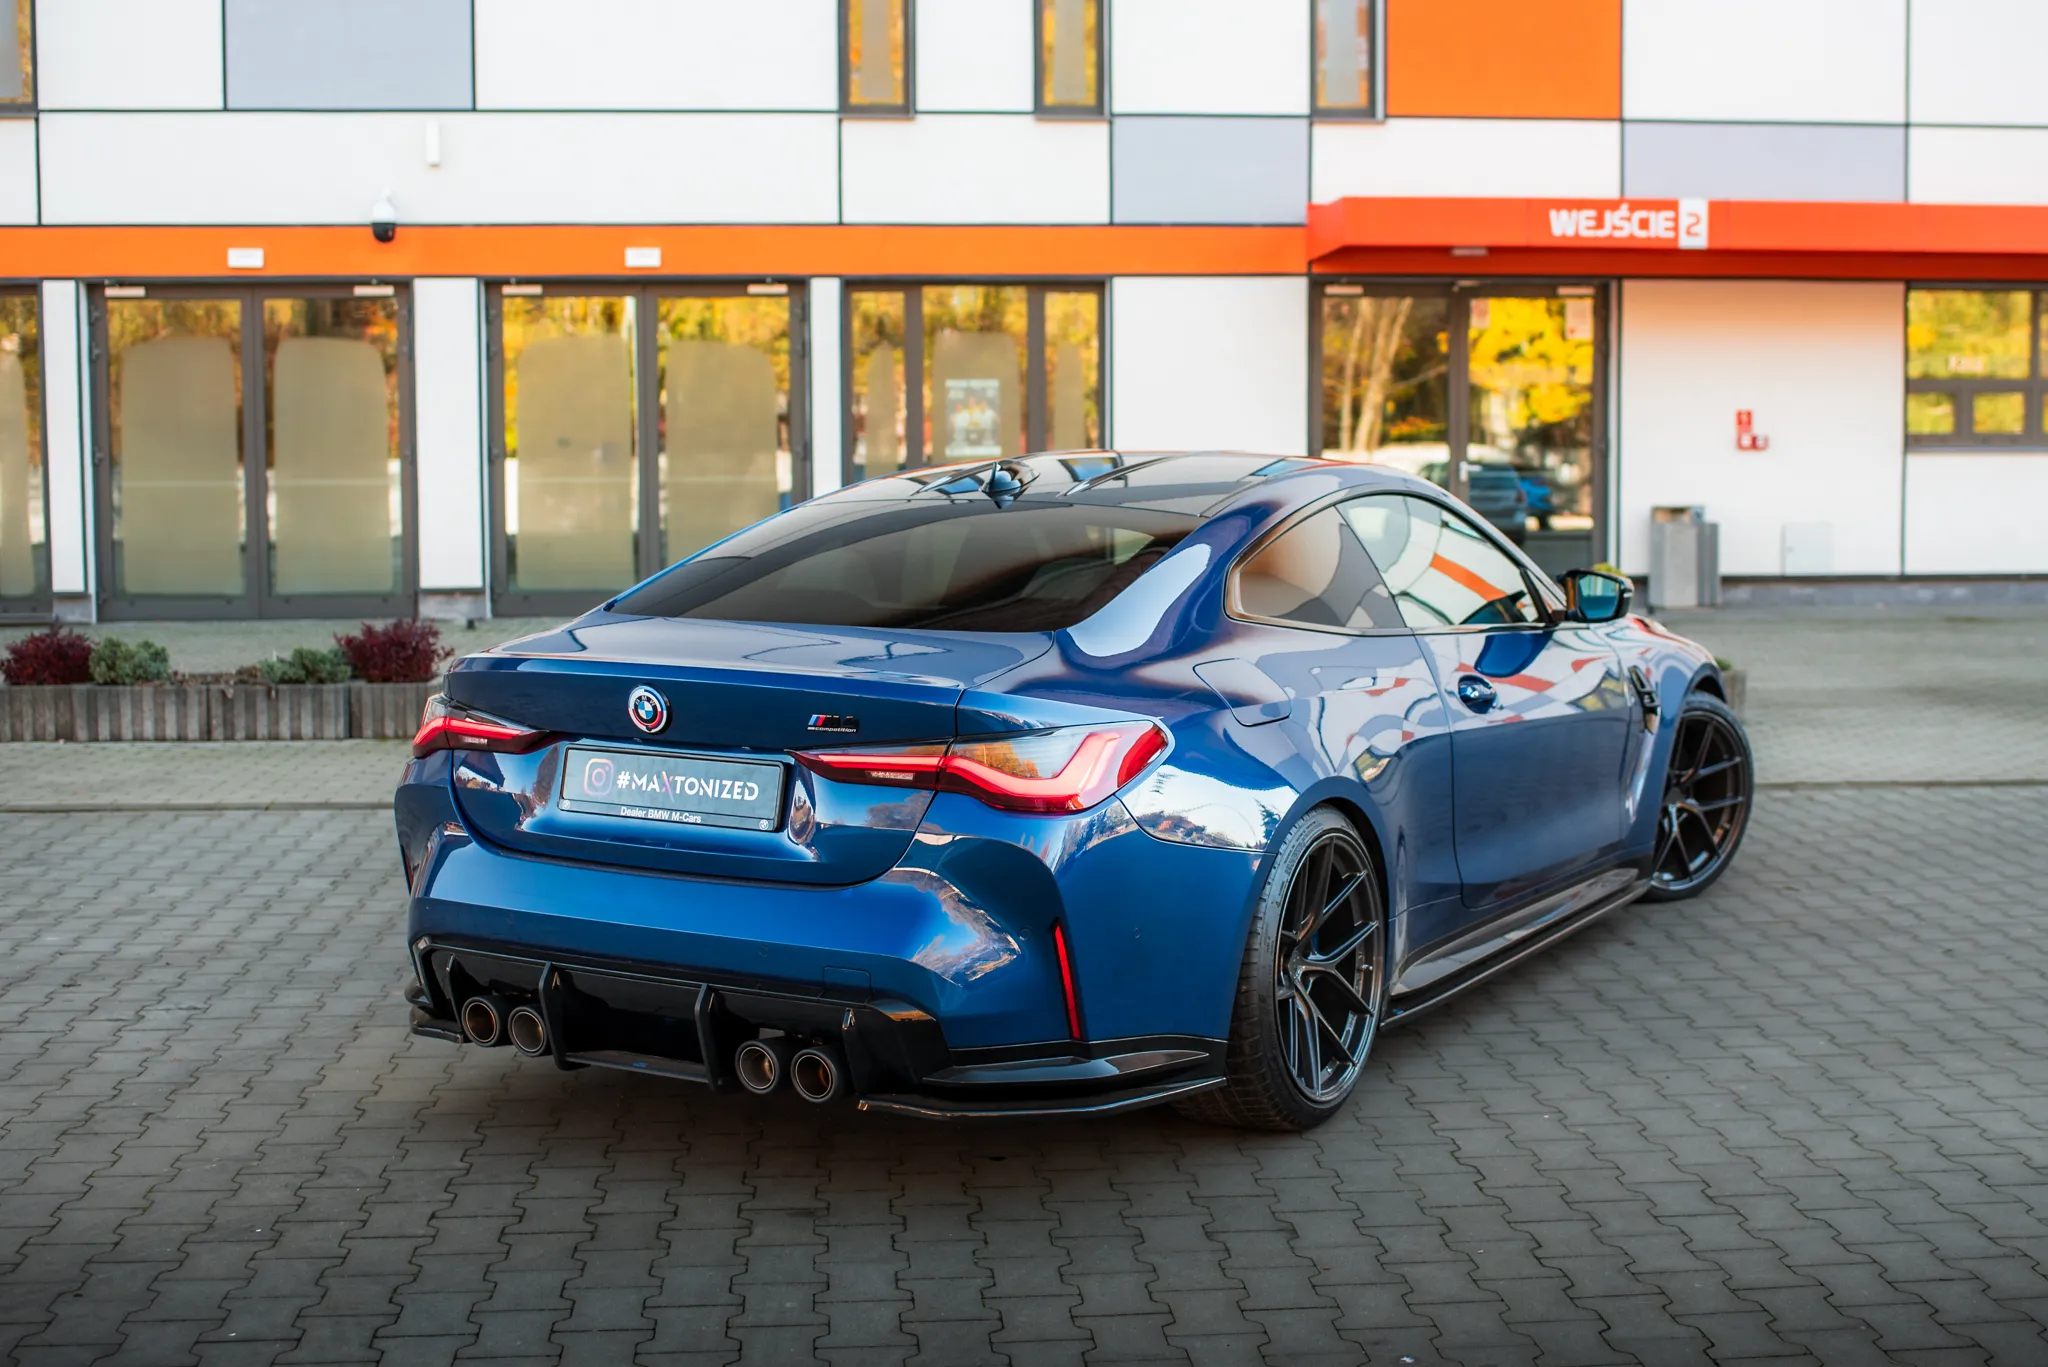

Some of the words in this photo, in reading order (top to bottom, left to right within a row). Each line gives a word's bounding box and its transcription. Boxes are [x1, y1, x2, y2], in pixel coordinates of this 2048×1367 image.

[1549, 203, 1676, 239] WEJŚCIE
[1685, 212, 1701, 238] 2
[635, 695, 656, 706] BMW
[616, 770, 760, 802] #MAXTONIZED
[620, 806, 647, 818] Dealer
[647, 809, 671, 820] BMW
[671, 811, 702, 823] M-Cars
